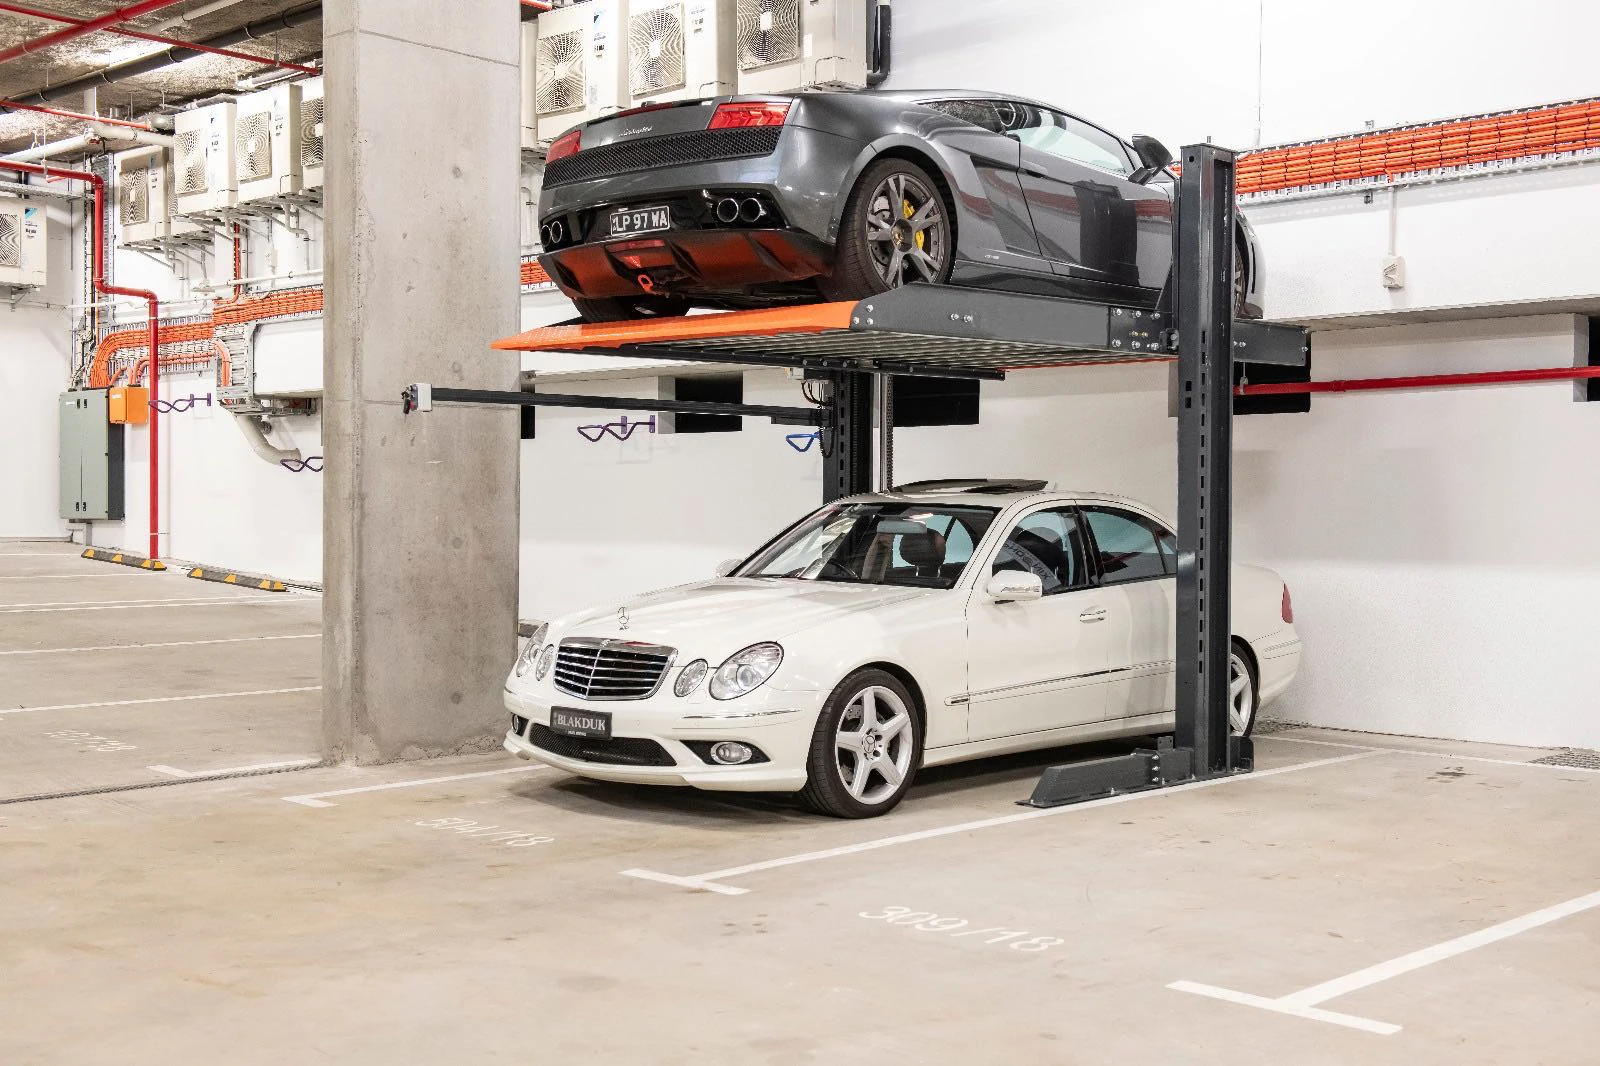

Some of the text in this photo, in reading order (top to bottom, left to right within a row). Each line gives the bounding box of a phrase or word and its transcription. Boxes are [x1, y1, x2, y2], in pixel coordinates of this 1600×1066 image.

[616, 215, 631, 232] LP
[633, 212, 649, 230] 97
[651, 210, 668, 227] WA
[557, 714, 606, 731] BLAKDUK
[858, 905, 1065, 953] 309/18
